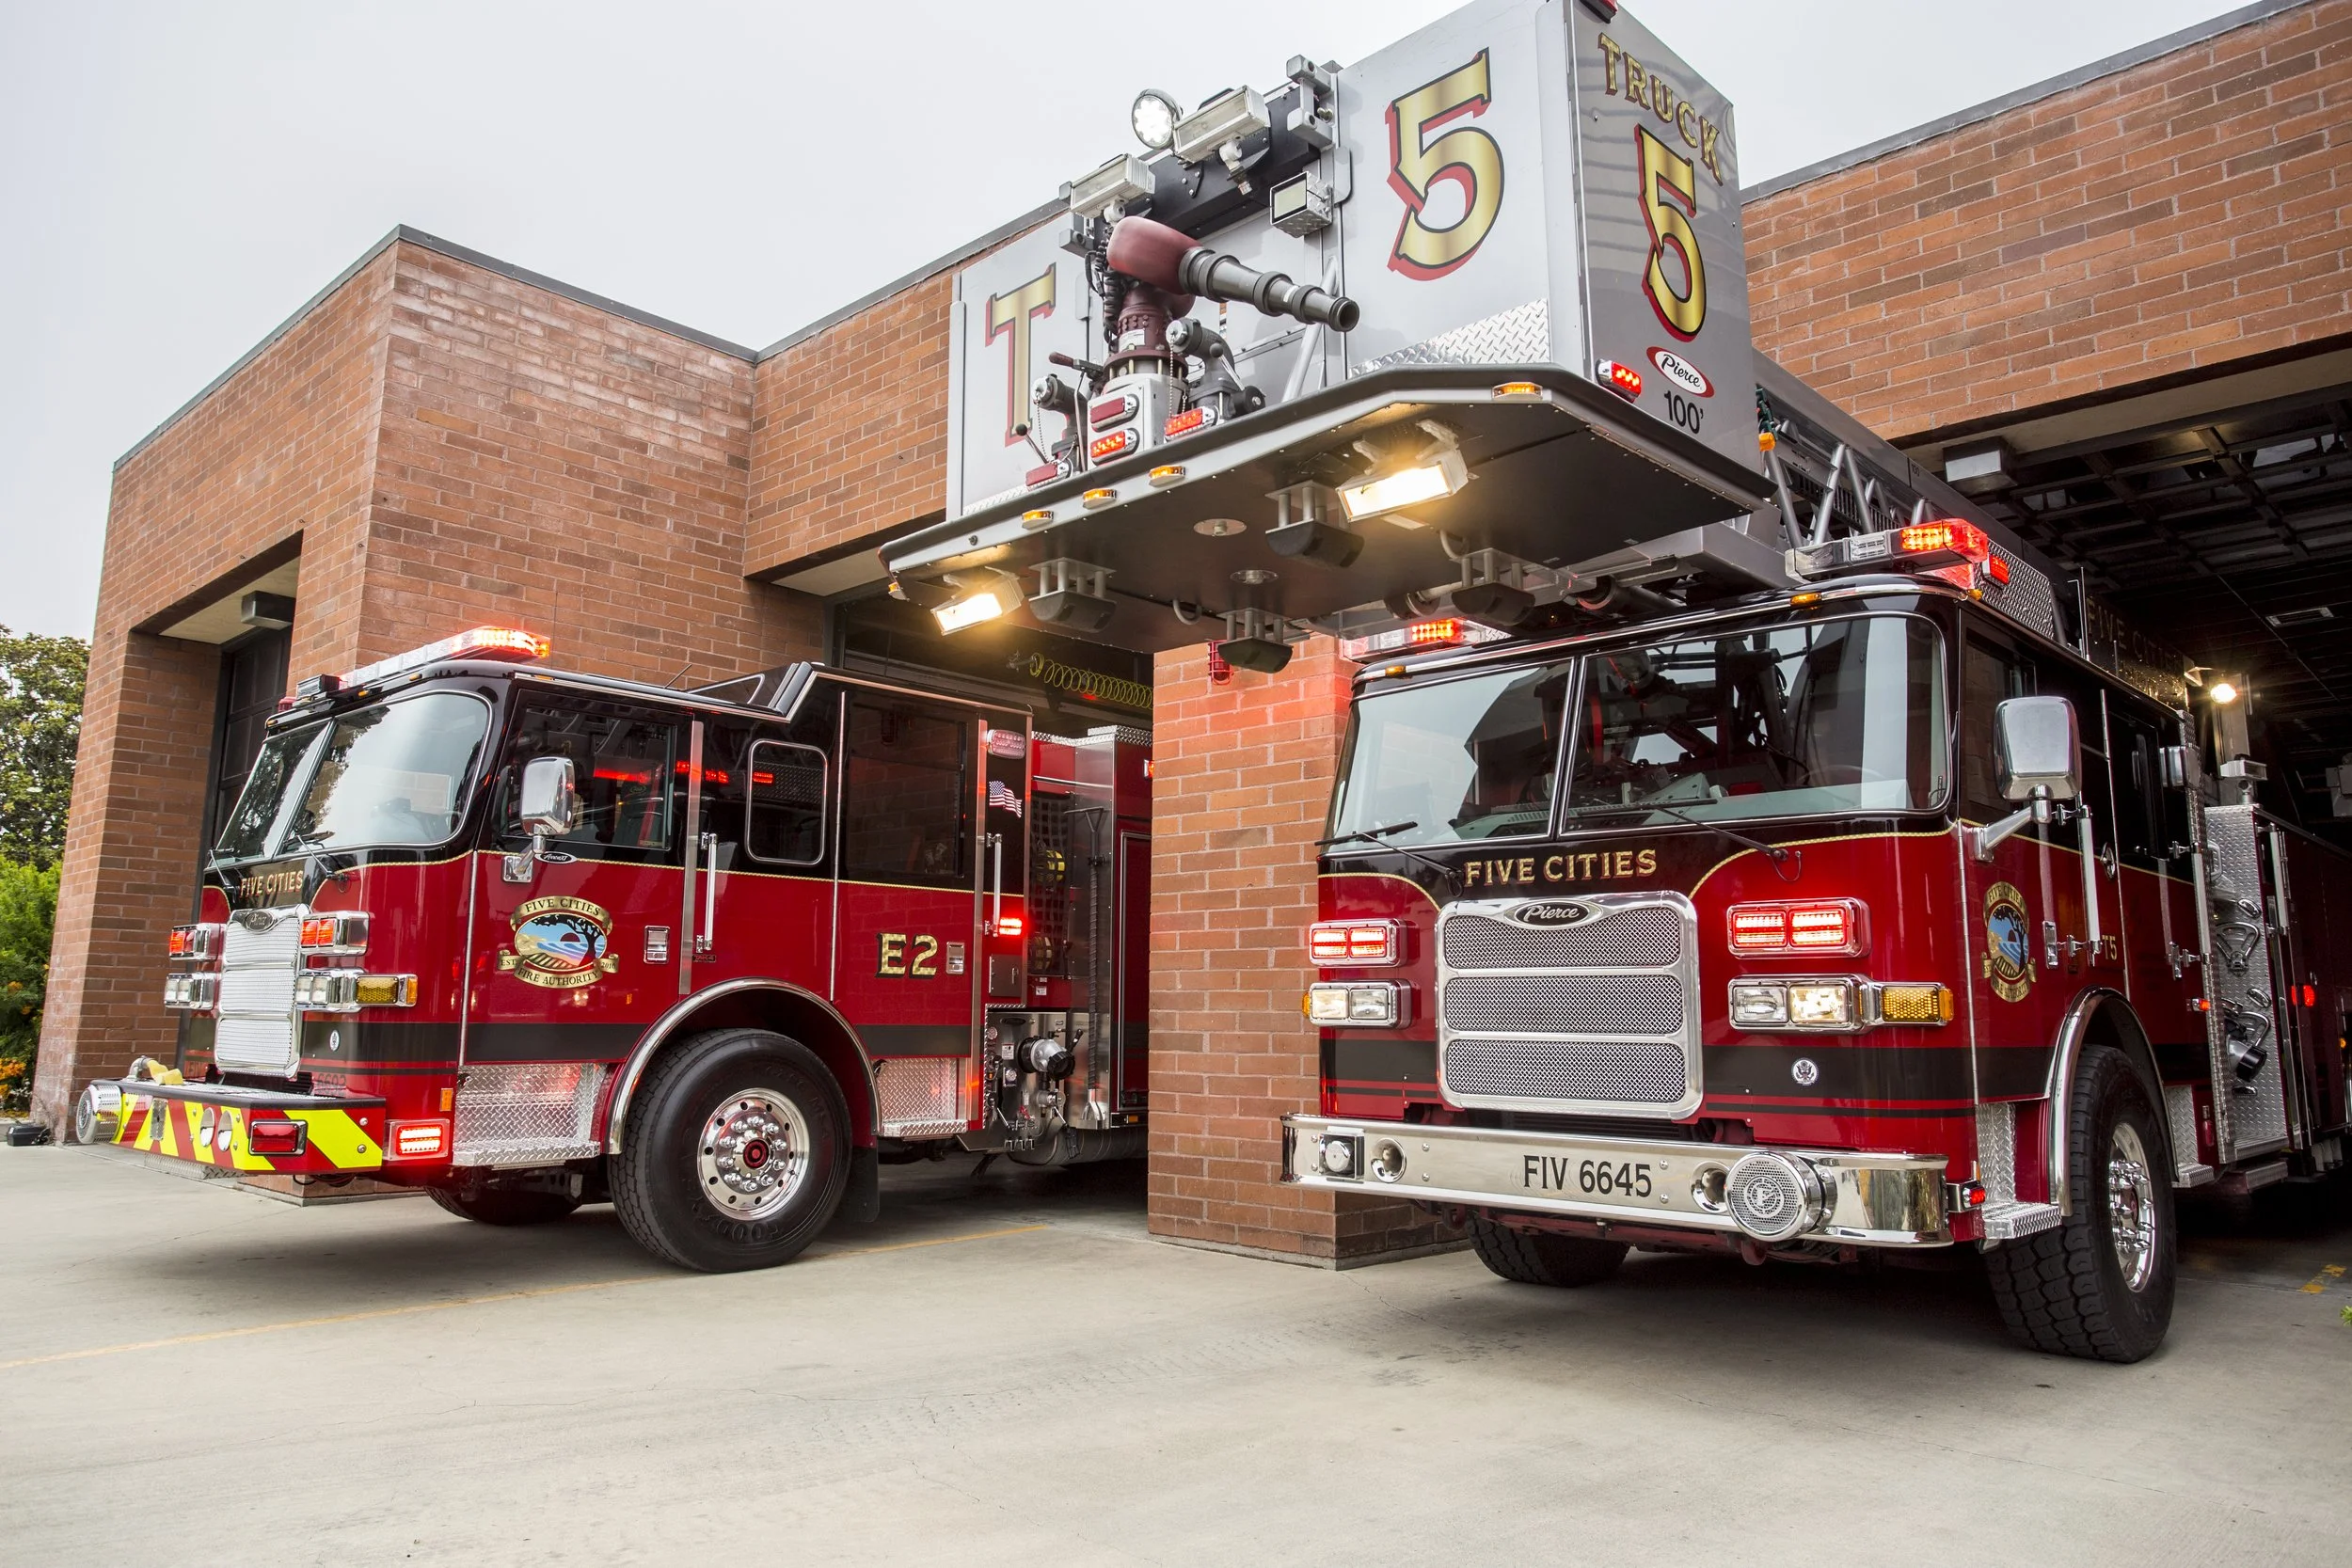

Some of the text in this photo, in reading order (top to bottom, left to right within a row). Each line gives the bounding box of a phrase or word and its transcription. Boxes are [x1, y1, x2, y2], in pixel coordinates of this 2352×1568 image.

[1597, 32, 1724, 187] TRUCK
[985, 46, 1505, 448] T 5
[1634, 123, 1707, 342] 5
[1661, 354, 1701, 388] Pierce
[239, 870, 304, 898] FIVE CITIES
[1464, 848, 1658, 888] FIVE CITIES
[525, 898, 601, 916] FIVE CITIES
[1522, 906, 1581, 925] Pierce
[875, 931, 939, 979] E2
[2101, 933, 2118, 961] T5
[517, 967, 599, 986] FIRE AUTHORITY
[1523, 1154, 1652, 1198] FIV 6645
